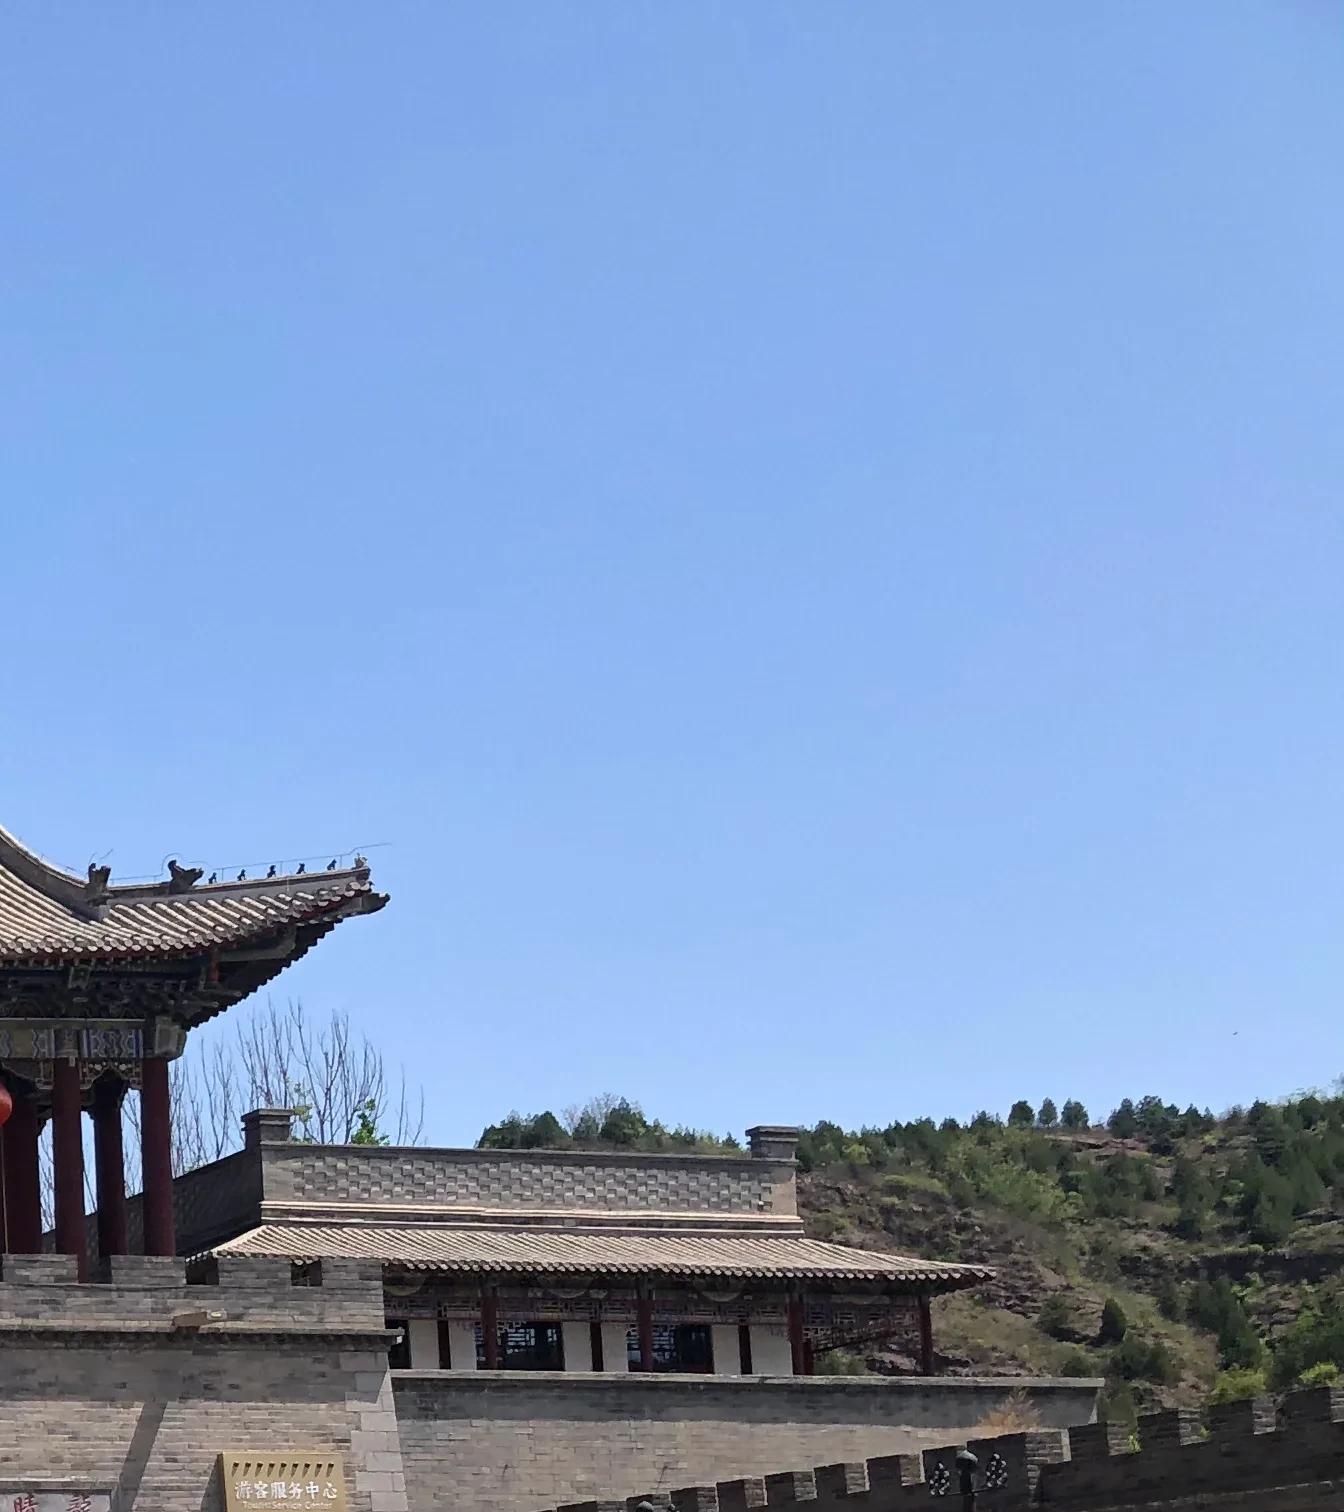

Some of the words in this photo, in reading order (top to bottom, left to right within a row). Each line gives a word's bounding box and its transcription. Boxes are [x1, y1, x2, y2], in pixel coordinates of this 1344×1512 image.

[234, 1480, 338, 1499] 游客服务中心
